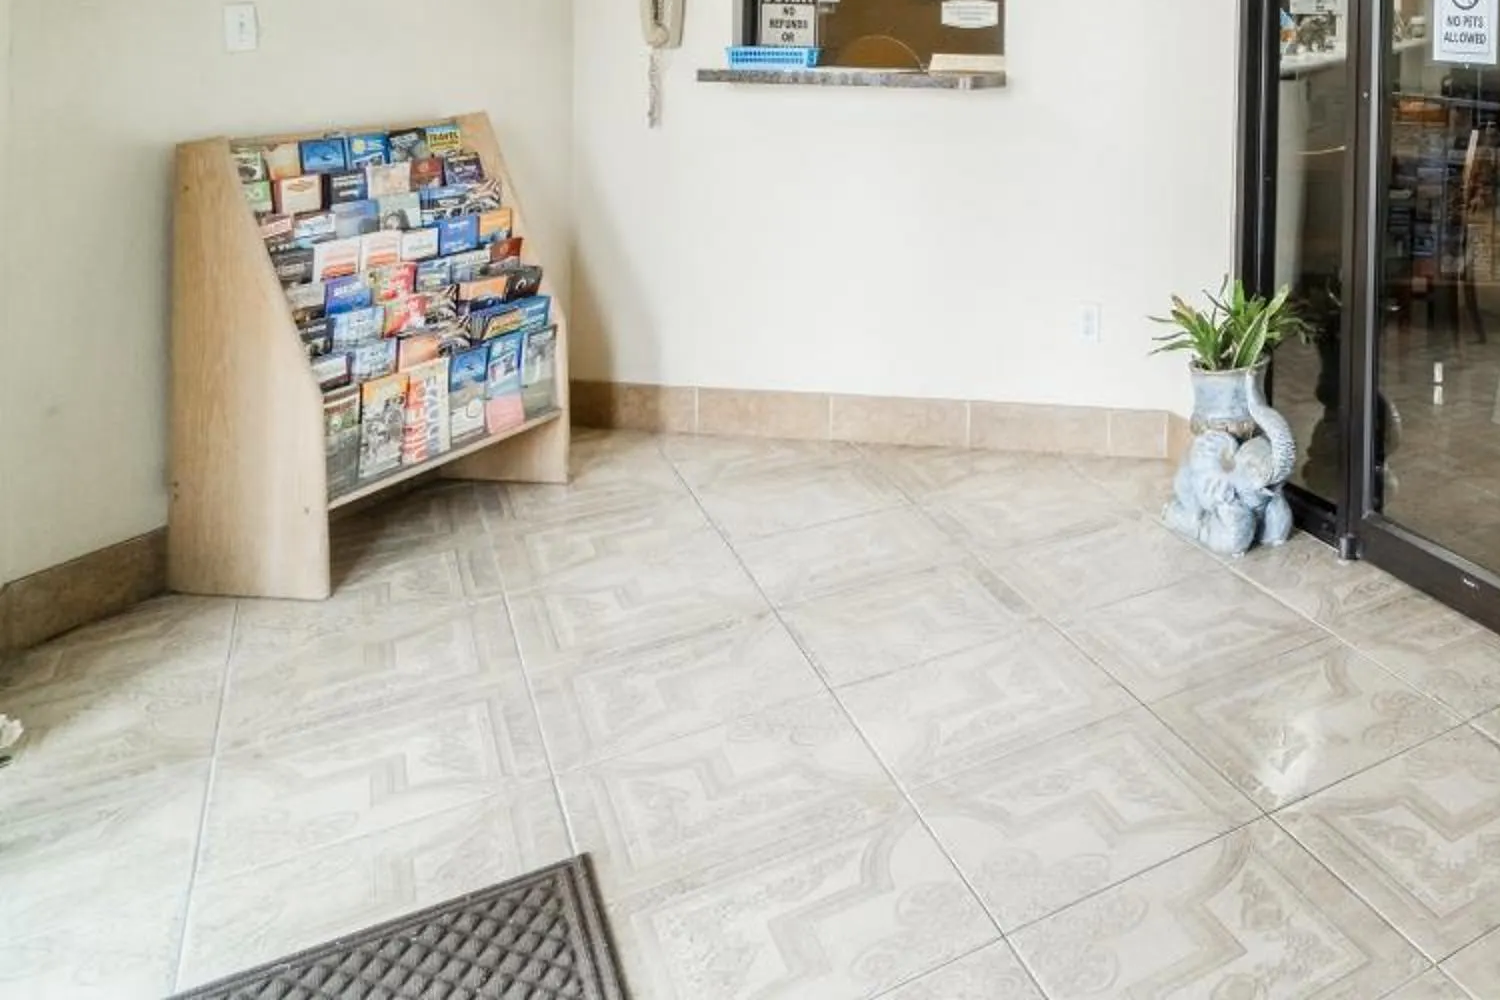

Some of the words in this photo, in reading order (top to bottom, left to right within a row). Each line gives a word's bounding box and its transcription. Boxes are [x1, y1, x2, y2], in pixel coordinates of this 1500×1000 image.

[1447, 15, 1460, 27] NO
[1463, 15, 1485, 28] PETS
[1444, 31, 1487, 44] ALLOWED
